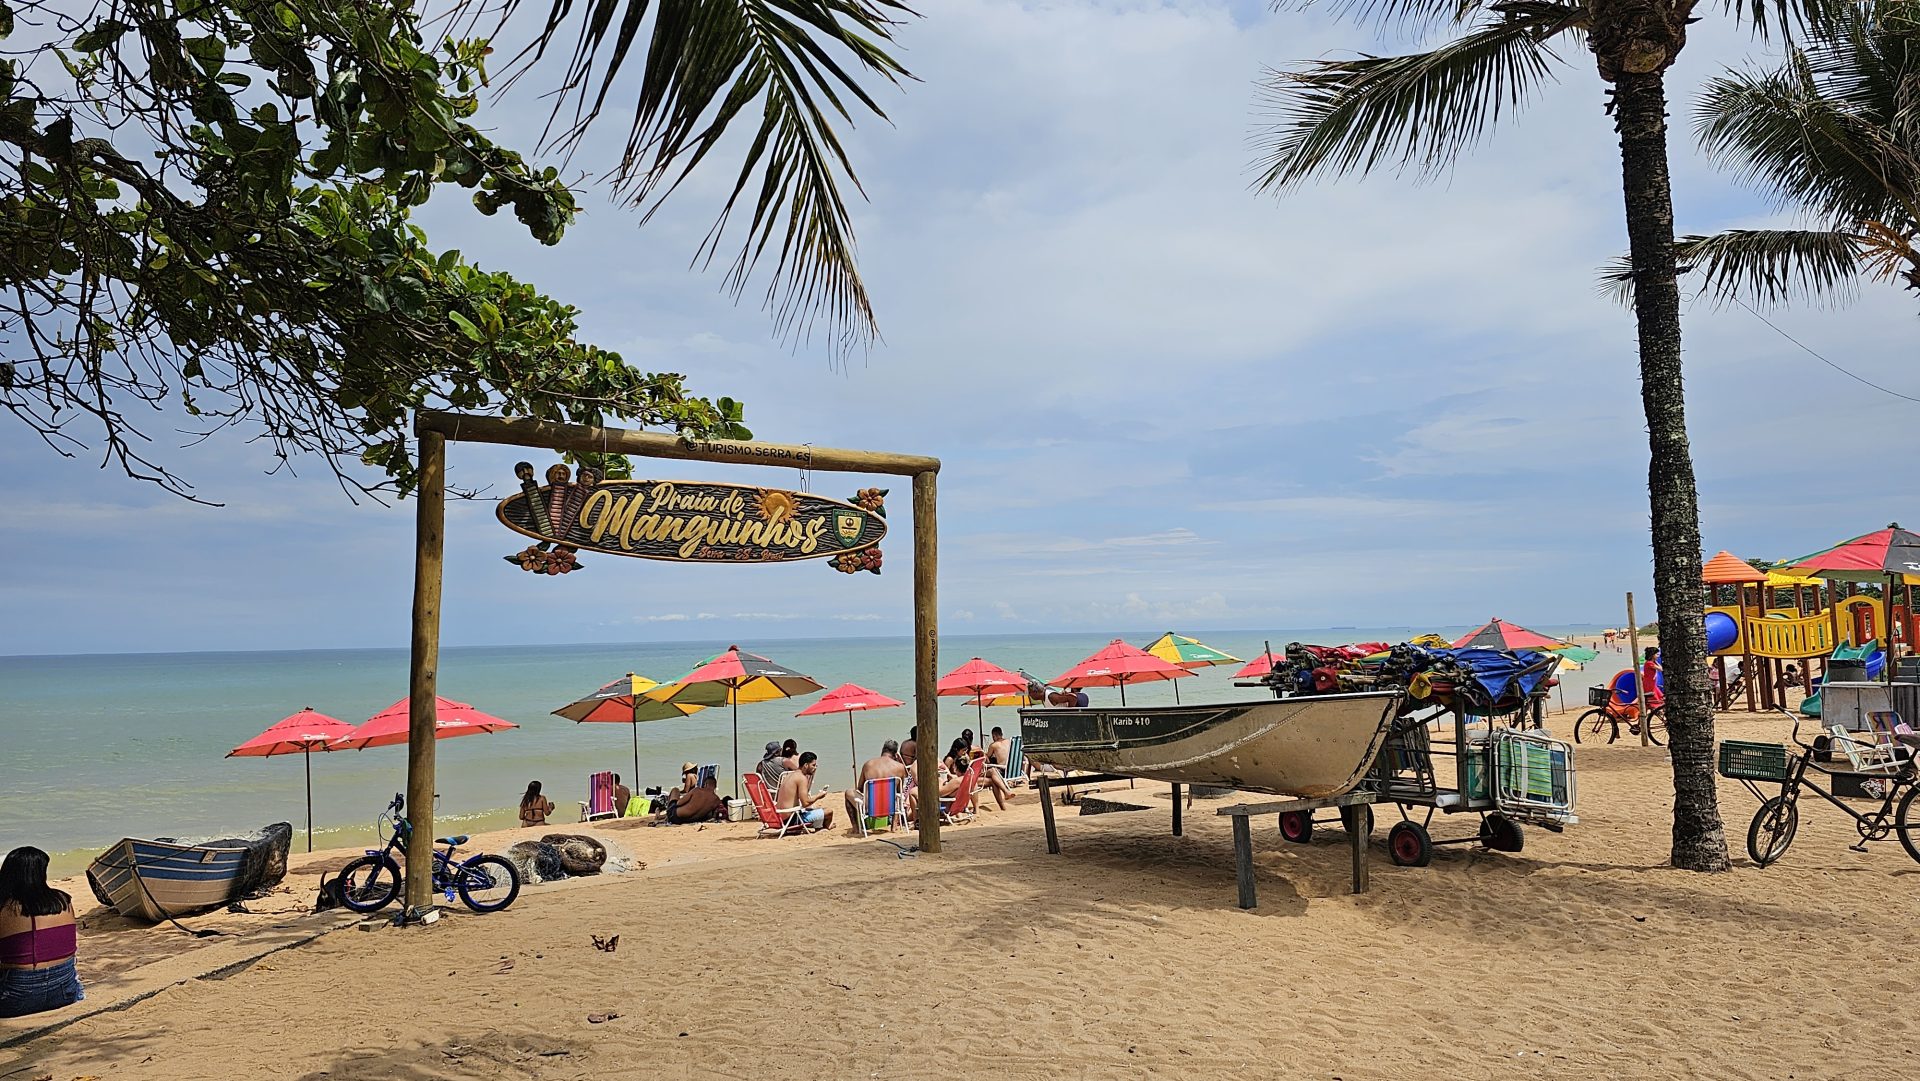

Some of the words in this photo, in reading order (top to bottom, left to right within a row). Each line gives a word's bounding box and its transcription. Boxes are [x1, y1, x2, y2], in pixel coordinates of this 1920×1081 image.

[647, 482, 720, 512] Praia
[720, 490, 746, 517] de
[580, 490, 827, 558] Manguinhos
[735, 547, 753, 560] ES
[1113, 717, 1133, 726] Karib
[1135, 717, 1150, 726] 410
